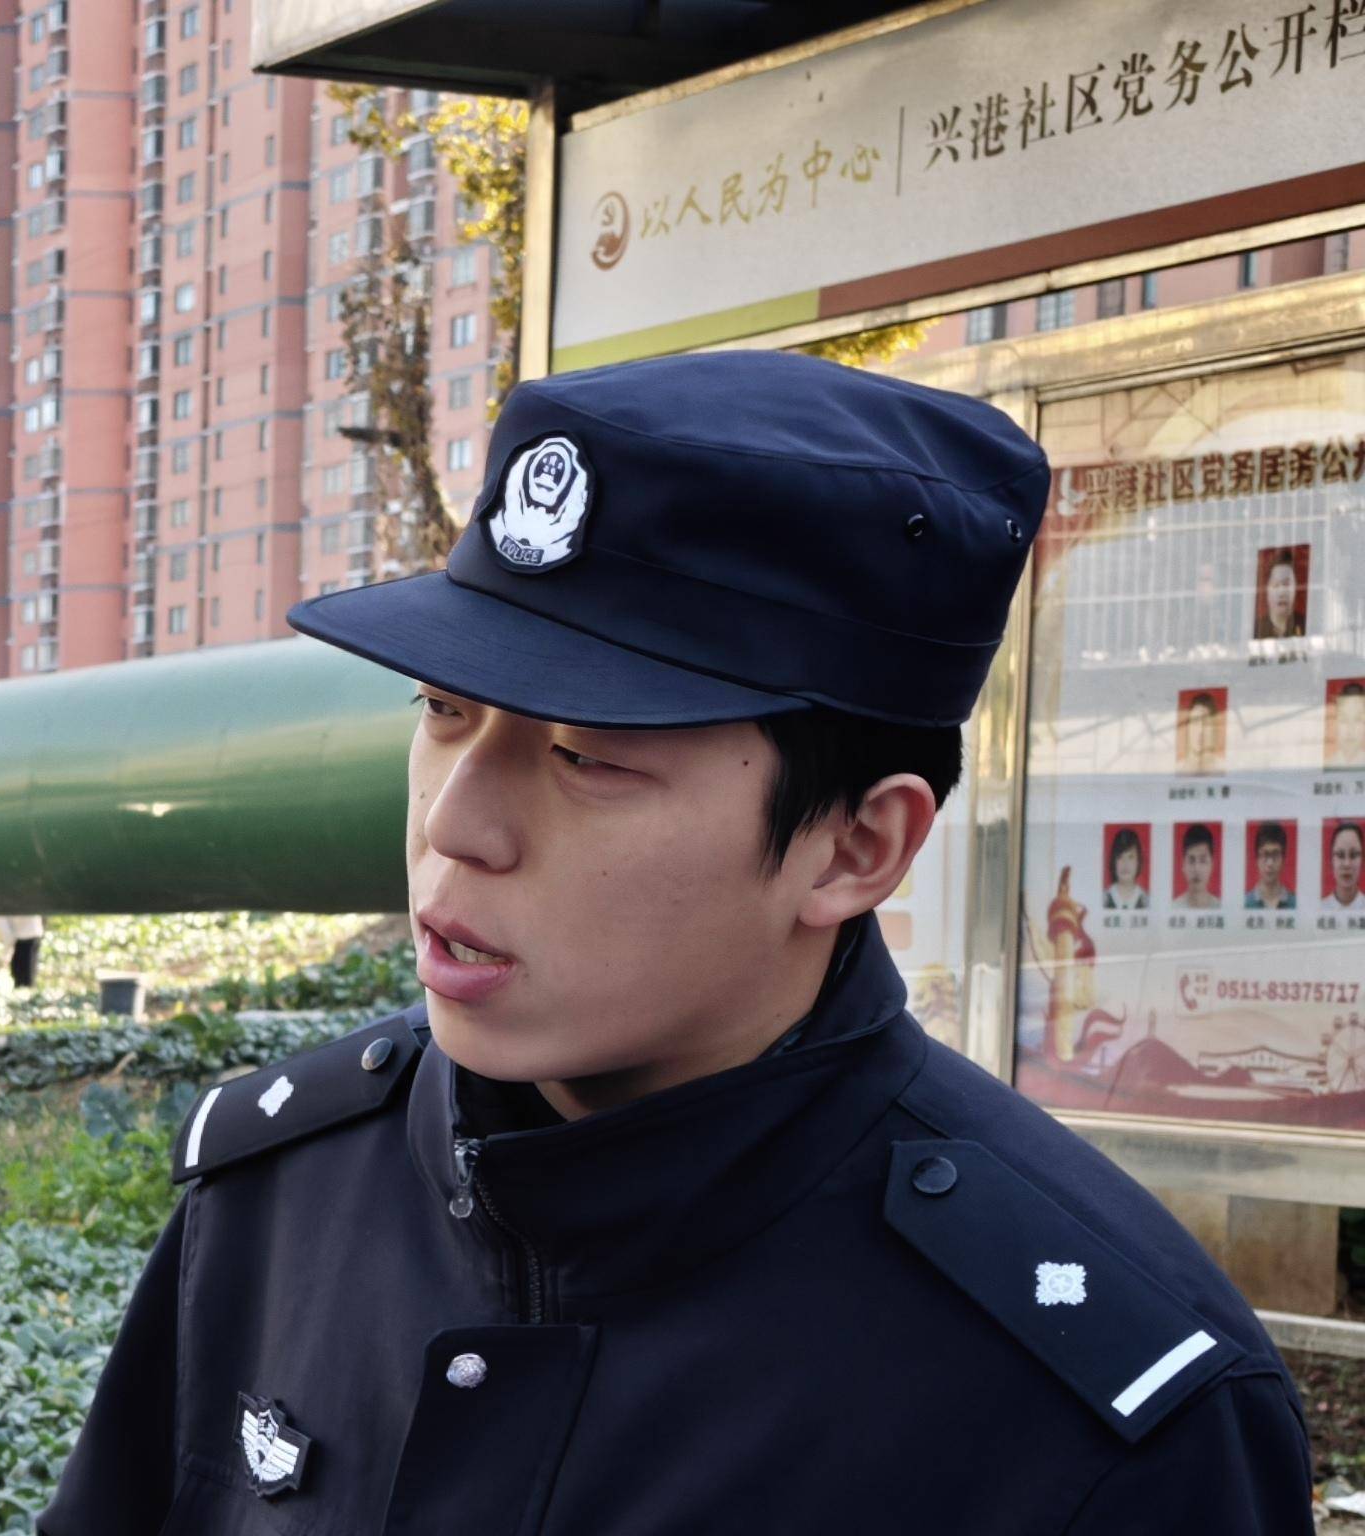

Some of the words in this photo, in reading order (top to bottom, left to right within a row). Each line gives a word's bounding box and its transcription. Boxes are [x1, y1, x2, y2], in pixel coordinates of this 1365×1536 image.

[640, 140, 881, 239] 以人民为中心
